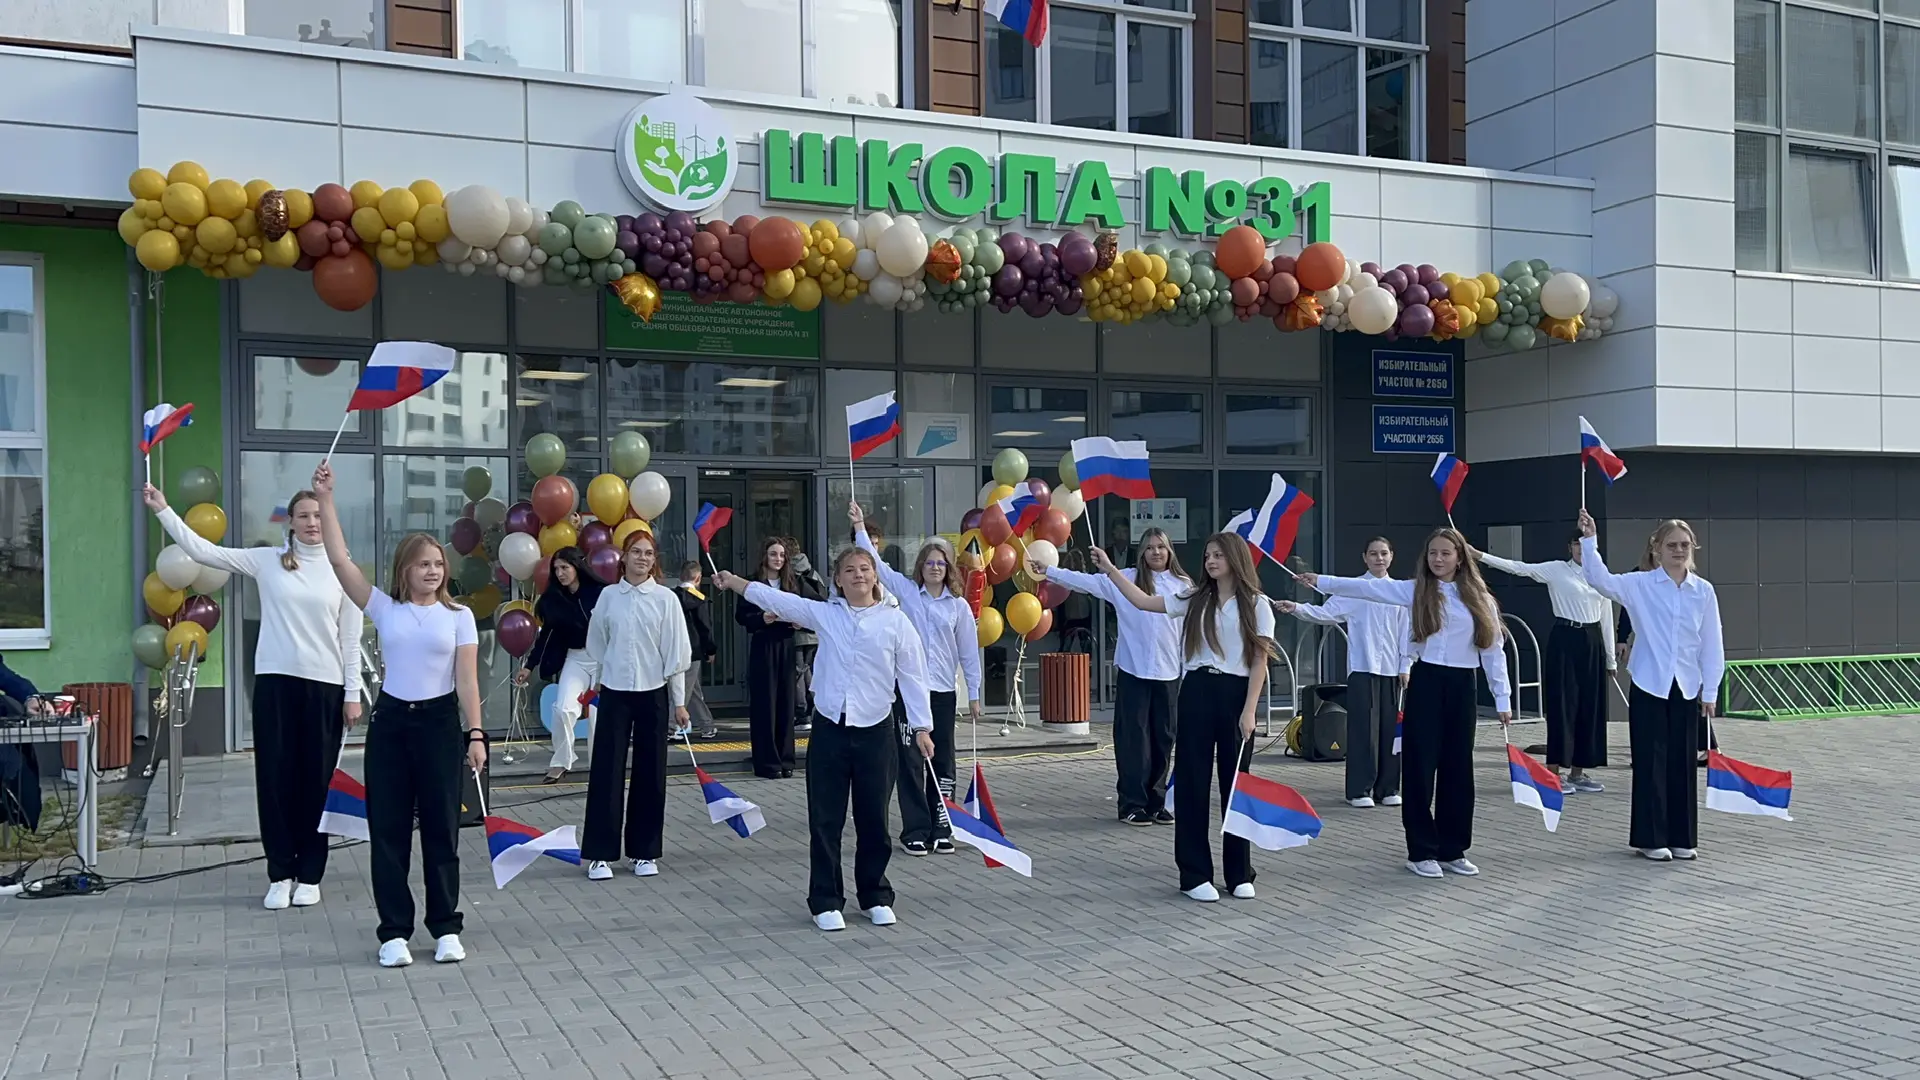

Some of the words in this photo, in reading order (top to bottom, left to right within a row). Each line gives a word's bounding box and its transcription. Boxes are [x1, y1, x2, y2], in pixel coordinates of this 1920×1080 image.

[764, 129, 1125, 229] ШКОЛА
[730, 307, 783, 318] АВТОНОМНОЕ
[652, 313, 743, 326] БЩЕОБРАЗОВАТЕЛЬНОЕ
[744, 318, 795, 328] УЧРЕЖДЕНИЕ
[631, 321, 668, 331] СРЕДНЯЯ
[669, 323, 765, 336] ОБЩЕОБРАЗОВАТЕЛЬНАЯ
[765, 328, 794, 337] ШКОЛА
[1378, 359, 1447, 372] ИЗБИРАТЕЛЬНЫЙ
[1378, 376, 1414, 388] УЧАСТОК
[1379, 414, 1449, 427] ИЗБИРАТЕЛЬНЫЙ
[1383, 433, 1418, 444] УЧАСТОК
[1426, 434, 1444, 444] 2656
